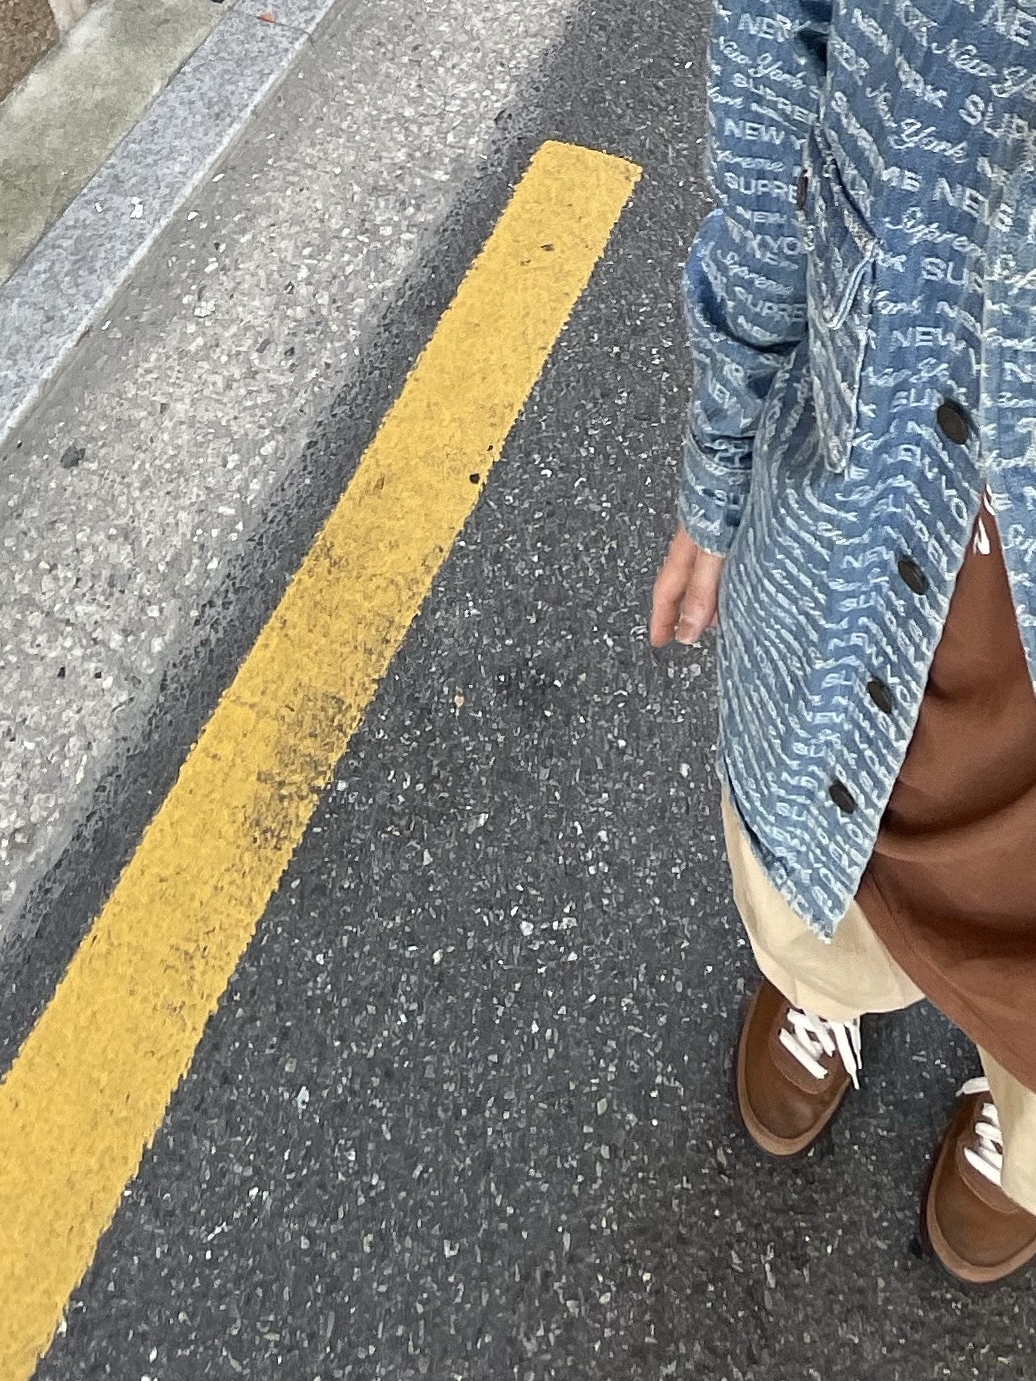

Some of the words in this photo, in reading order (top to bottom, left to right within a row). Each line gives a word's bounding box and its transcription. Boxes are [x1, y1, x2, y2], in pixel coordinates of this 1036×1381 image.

[723, 118, 785, 145] NEW
[887, 118, 968, 164] York
[723, 171, 799, 205] SUPRE
